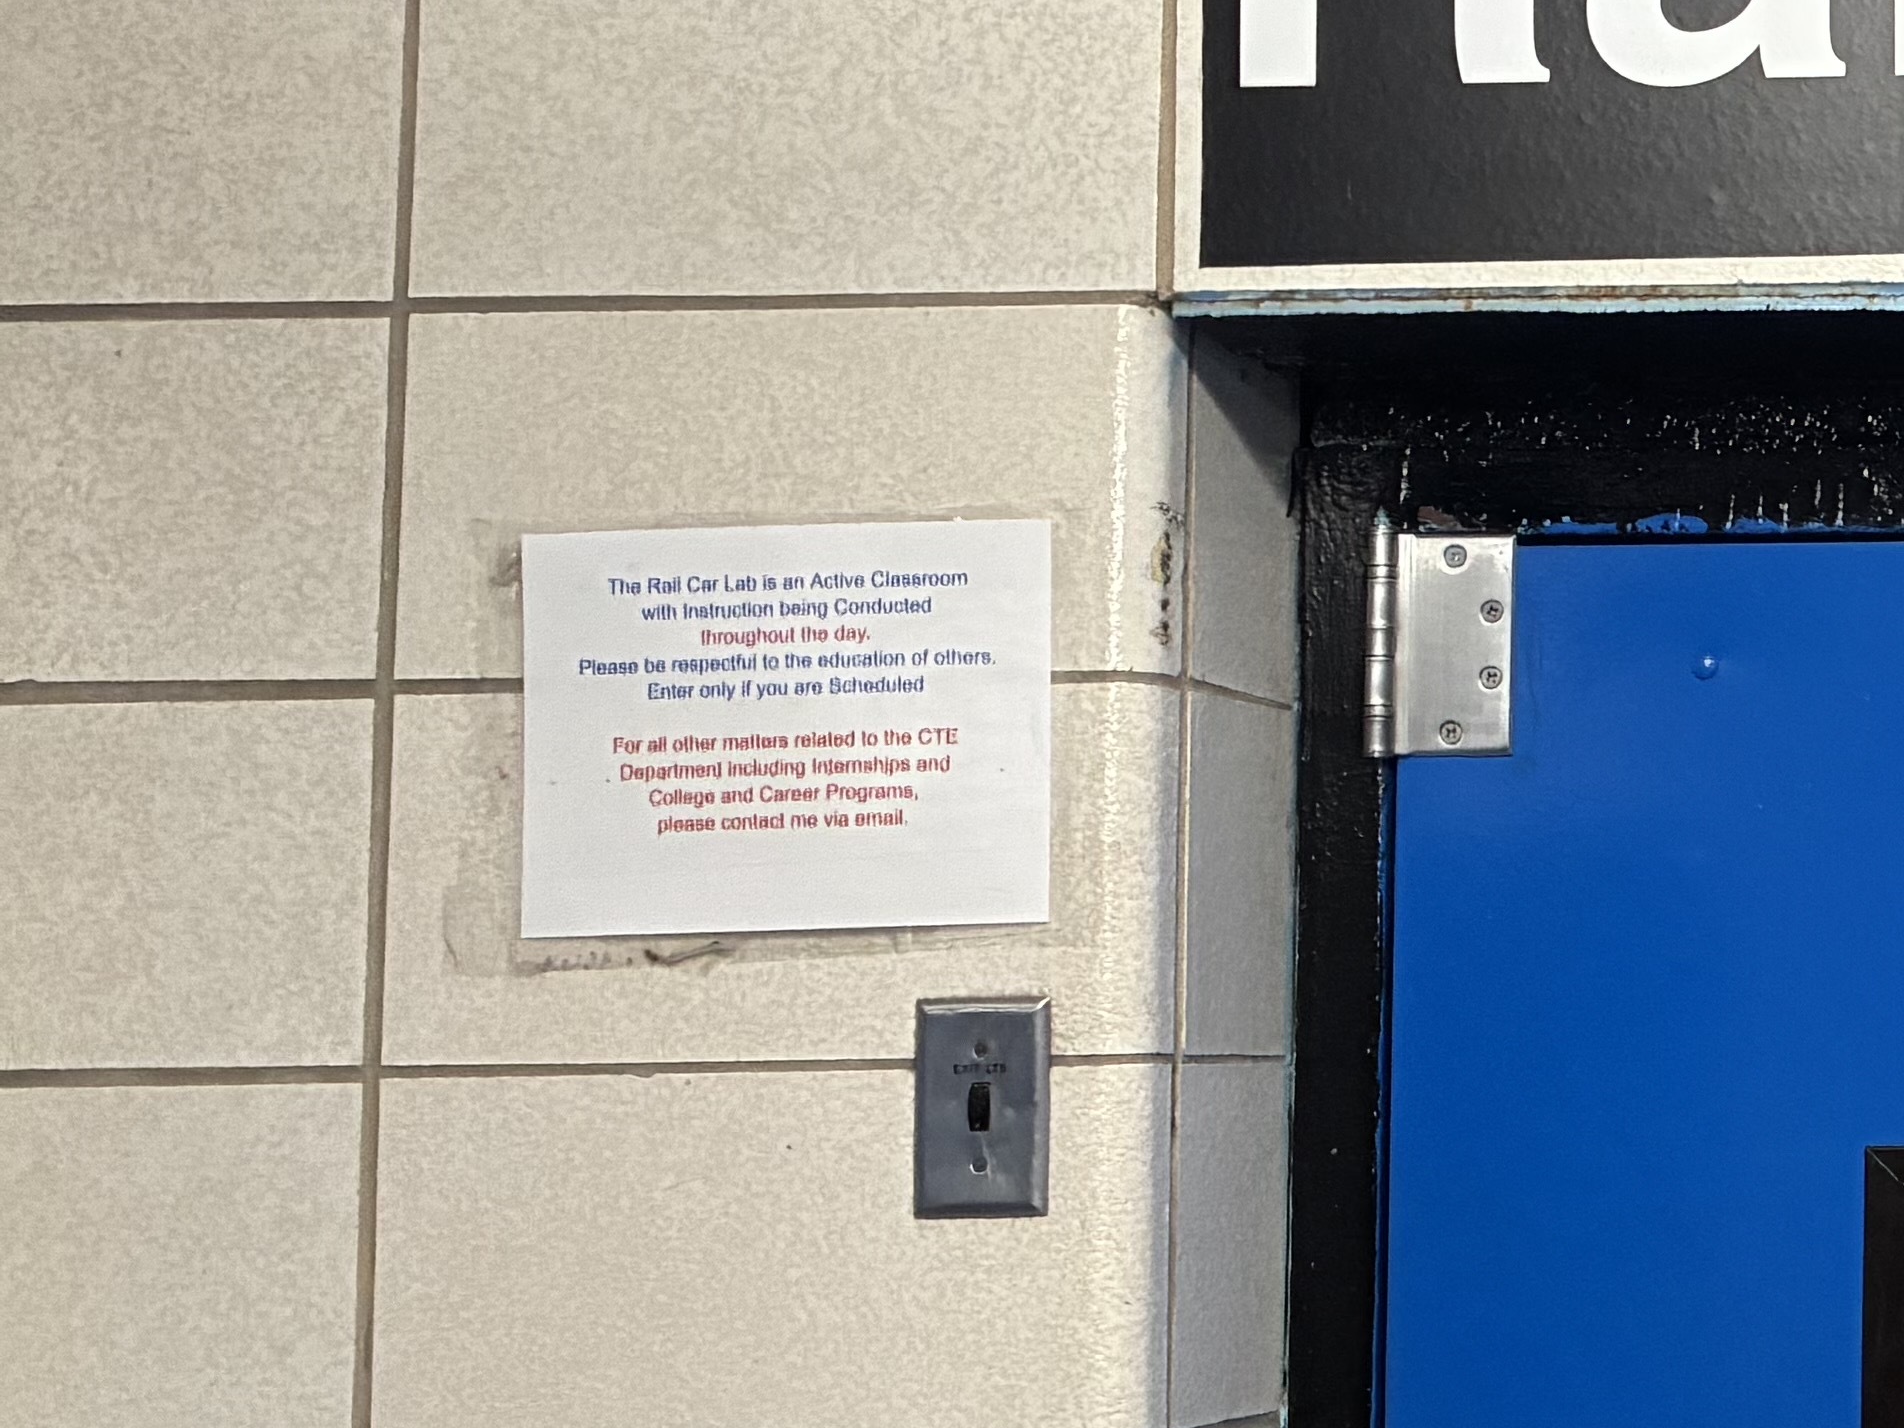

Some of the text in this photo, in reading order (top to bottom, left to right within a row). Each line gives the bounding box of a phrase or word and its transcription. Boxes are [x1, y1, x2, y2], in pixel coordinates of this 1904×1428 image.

[608, 569, 969, 596] The Rail Car Lab is an Active Classroom
[641, 603, 677, 621] with
[779, 599, 828, 620] being
[834, 596, 932, 616] Conducted
[701, 625, 870, 649] throughout the day.
[579, 648, 997, 677] Please be respectful to the education of others.
[648, 682, 694, 701] Enter
[699, 680, 736, 701] only
[756, 681, 789, 701] you
[794, 680, 823, 696] are
[829, 676, 925, 695] Scheduled
[613, 727, 959, 755] For all other matters related to the CTE
[620, 761, 722, 783] Department
[812, 755, 911, 777] Internships
[916, 754, 951, 773] and
[649, 788, 715, 810] College
[720, 786, 754, 805] and
[760, 784, 820, 803] Career
[657, 815, 716, 836] please
[721, 812, 785, 831] contact
[790, 813, 818, 830] me
[824, 810, 850, 828] via
